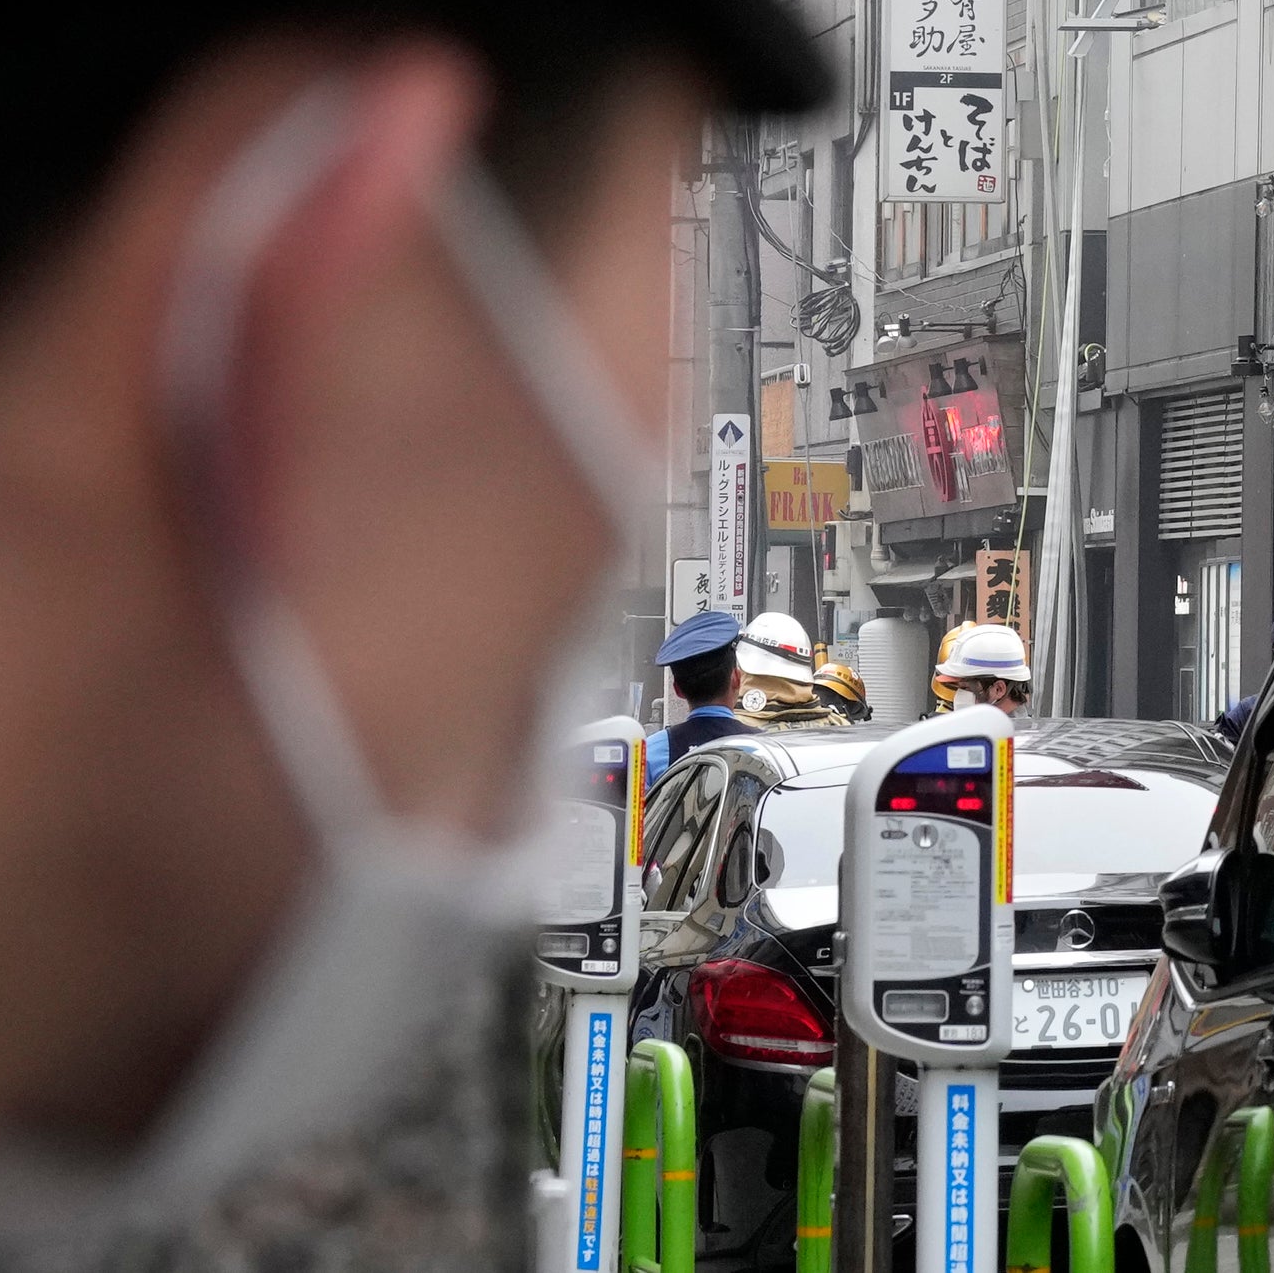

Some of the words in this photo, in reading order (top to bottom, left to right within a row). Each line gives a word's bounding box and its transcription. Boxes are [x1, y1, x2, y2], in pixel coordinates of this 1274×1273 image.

[940, 73, 954, 84] 2F
[893, 92, 912, 106] 1F
[959, 93, 996, 173] そば
[770, 491, 835, 522] FRANK
[986, 558, 1021, 636] 大衆
[1014, 1016, 1030, 1033] と
